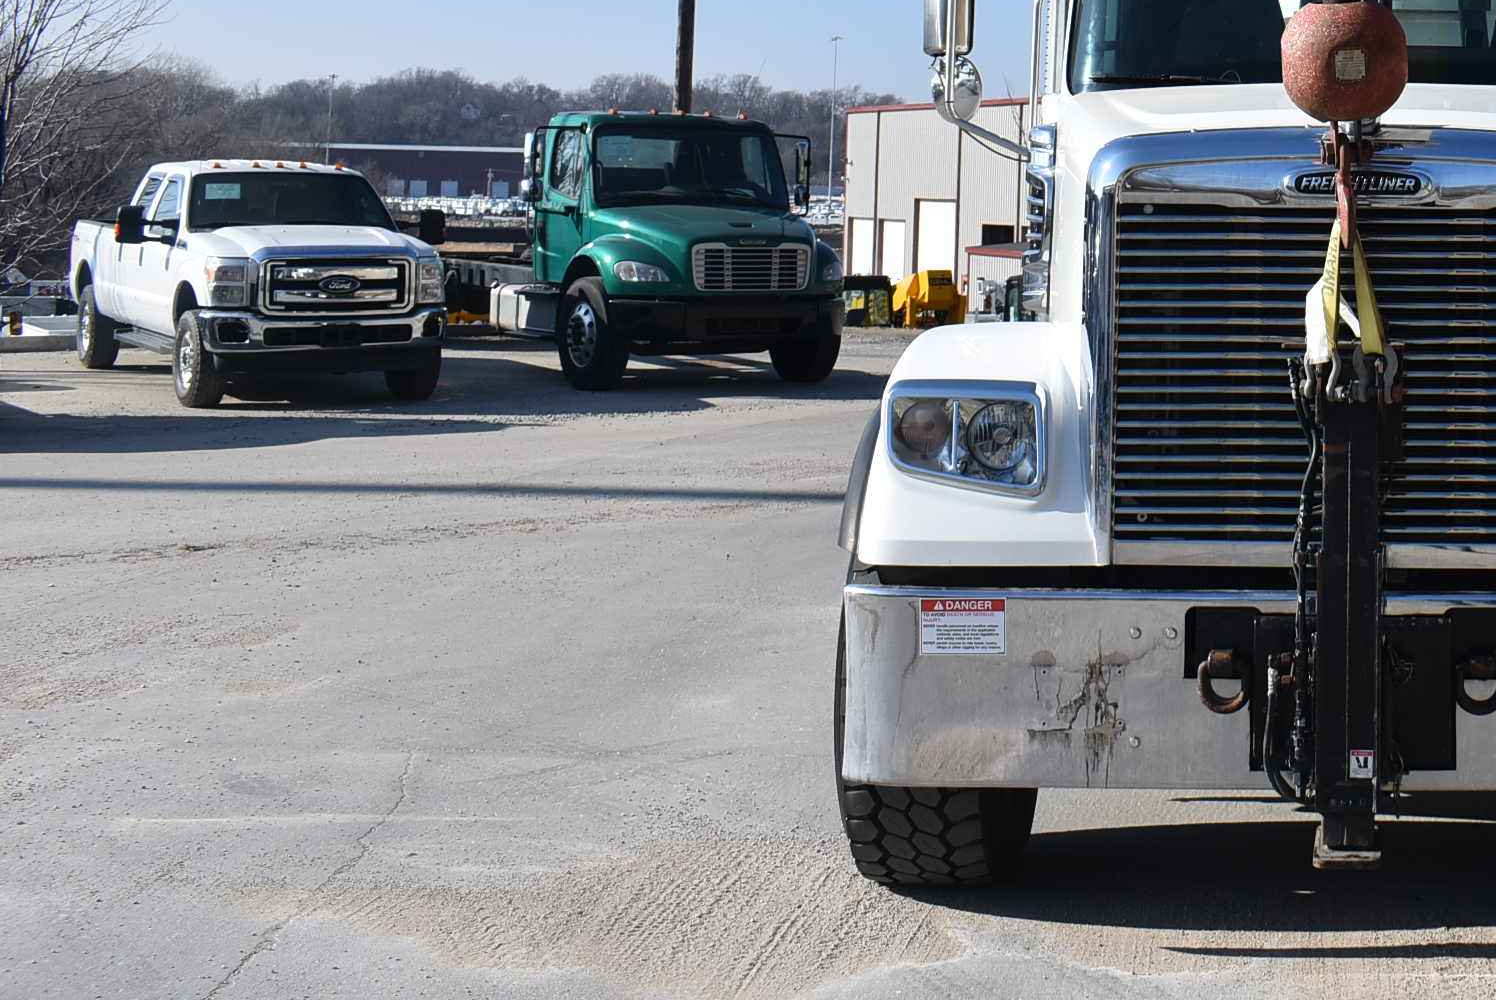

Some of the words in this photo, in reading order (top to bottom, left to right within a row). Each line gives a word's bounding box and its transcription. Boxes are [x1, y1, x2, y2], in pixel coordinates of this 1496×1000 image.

[1300, 175, 1416, 191] FREIHTLINER
[328, 279, 352, 289] Ford
[945, 600, 992, 610] DANGER
